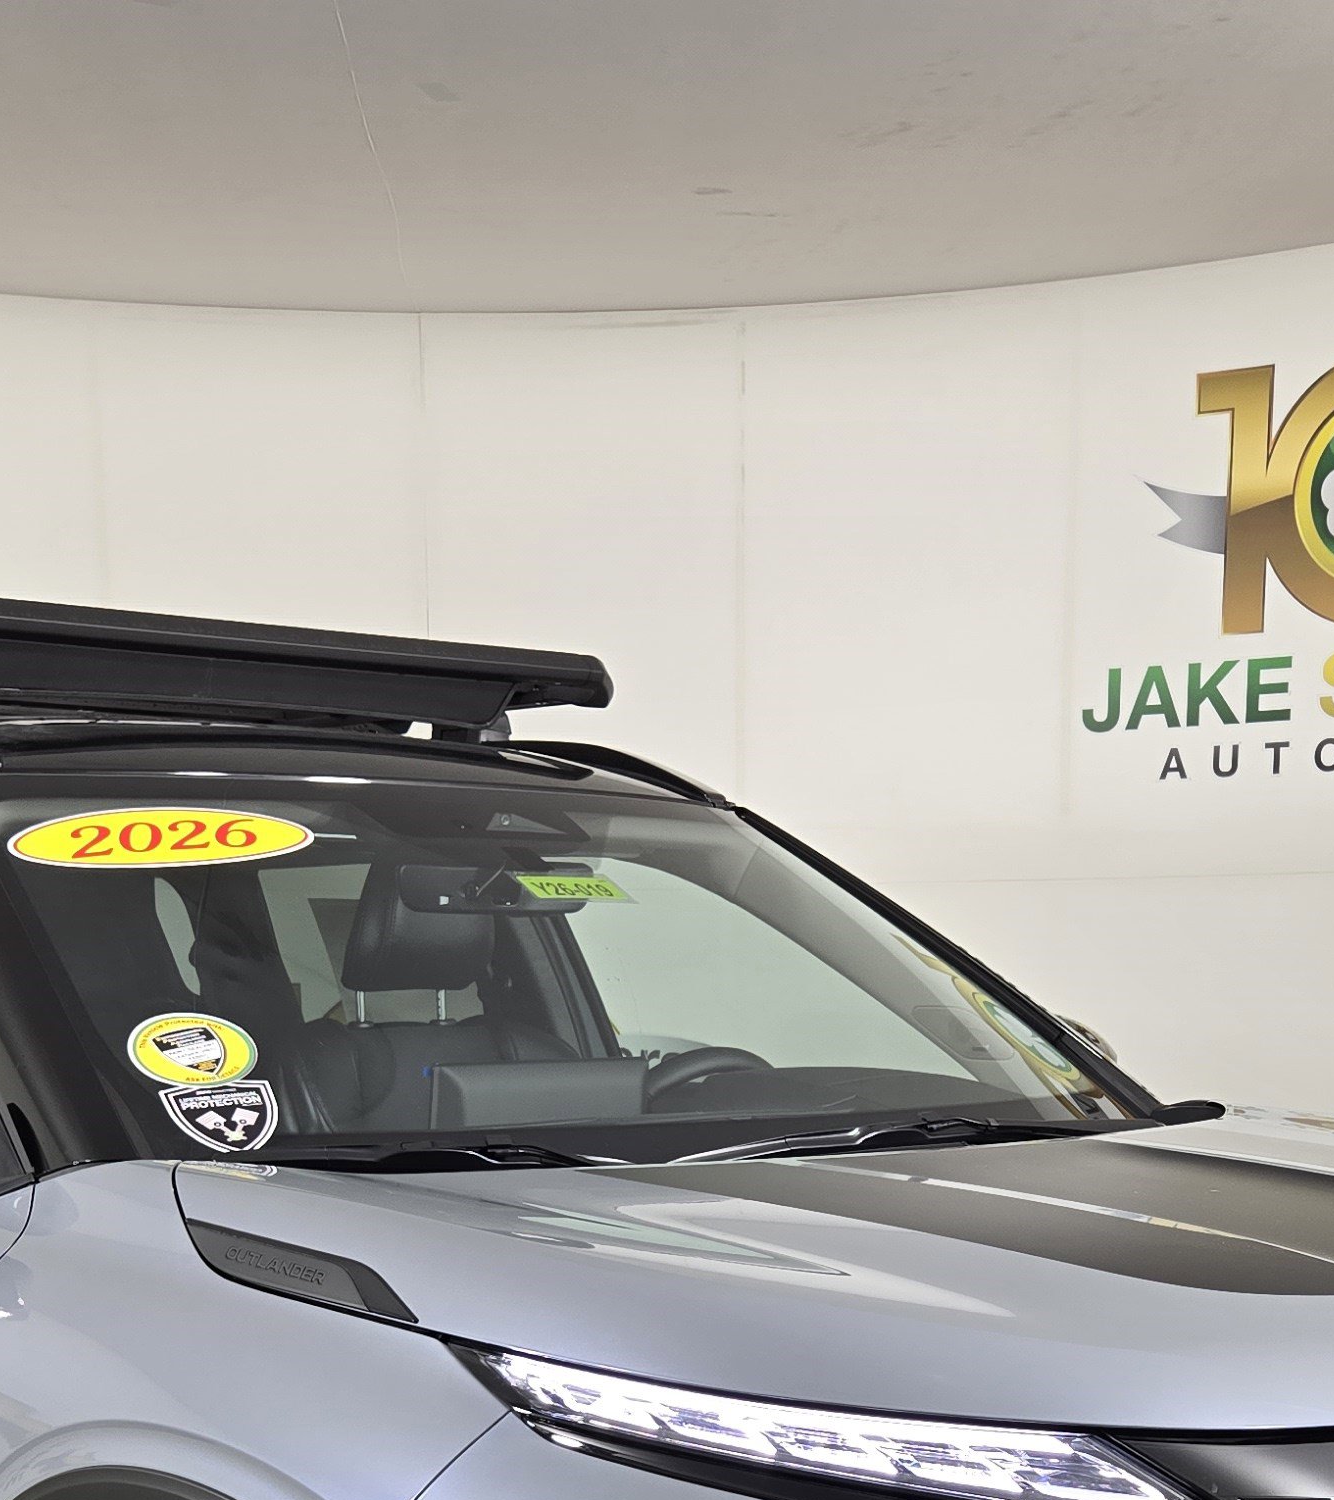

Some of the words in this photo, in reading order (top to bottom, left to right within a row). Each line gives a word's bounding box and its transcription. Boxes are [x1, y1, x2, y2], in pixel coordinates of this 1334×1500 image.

[1081, 654, 1294, 733] JAKE
[70, 818, 258, 859] 2026
[530, 881, 615, 898] Y26-019
[179, 1095, 263, 1111] PROTECTION
[225, 1245, 326, 1286] OUTLANDER
